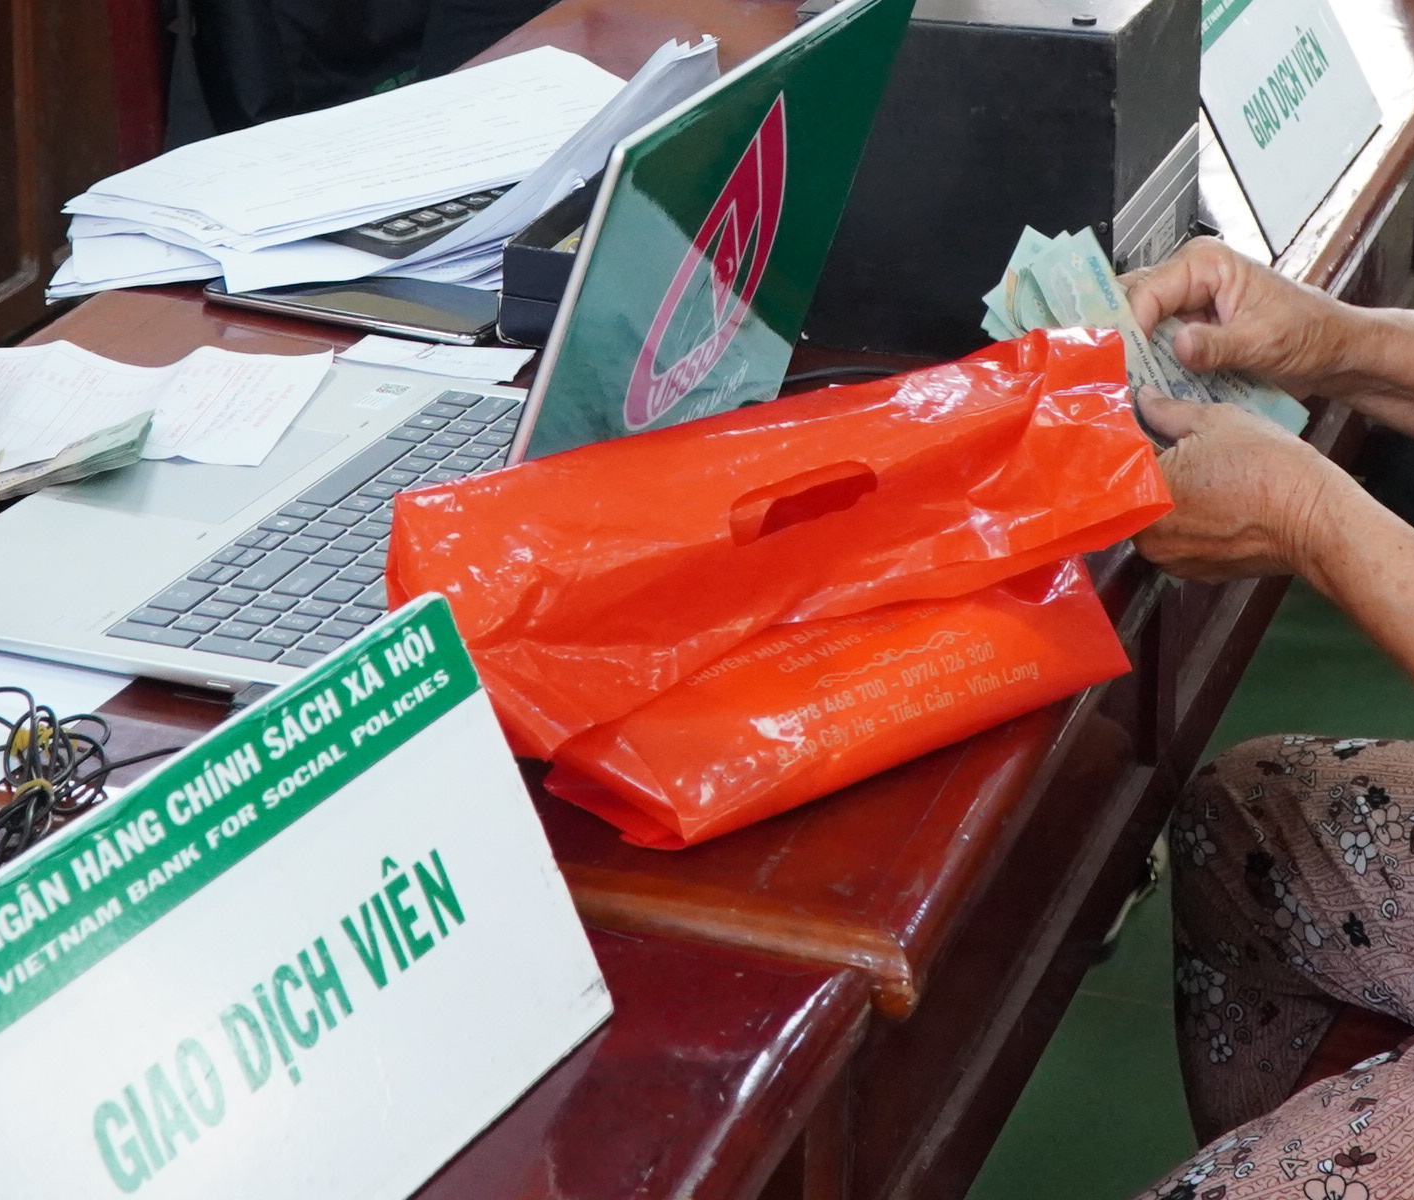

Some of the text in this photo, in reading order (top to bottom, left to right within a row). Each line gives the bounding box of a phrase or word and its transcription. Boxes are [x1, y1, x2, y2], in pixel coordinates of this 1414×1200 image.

[1243, 24, 1330, 151] GIAO DỊCH VIÊN
[69, 808, 167, 892] HÀNG
[165, 742, 263, 827] CHÍNH
[262, 687, 343, 761] SÁCH
[340, 654, 386, 707] XÃ
[383, 624, 437, 678] HỘI
[818, 726, 850, 752] Cây
[965, 672, 1002, 696] Vĩnh
[1001, 661, 1041, 685] Long
[824, 688, 857, 716] 468
[857, 677, 888, 704] 700
[900, 660, 939, 688] 0974
[939, 651, 966, 675] 126
[965, 640, 995, 666] 300
[125, 842, 203, 905] BANK
[204, 801, 259, 850] FOR
[261, 743, 348, 810] SOCIAL
[349, 668, 451, 747] POLICIES
[92, 847, 467, 1194] GIAO DỊCH VIÊN
